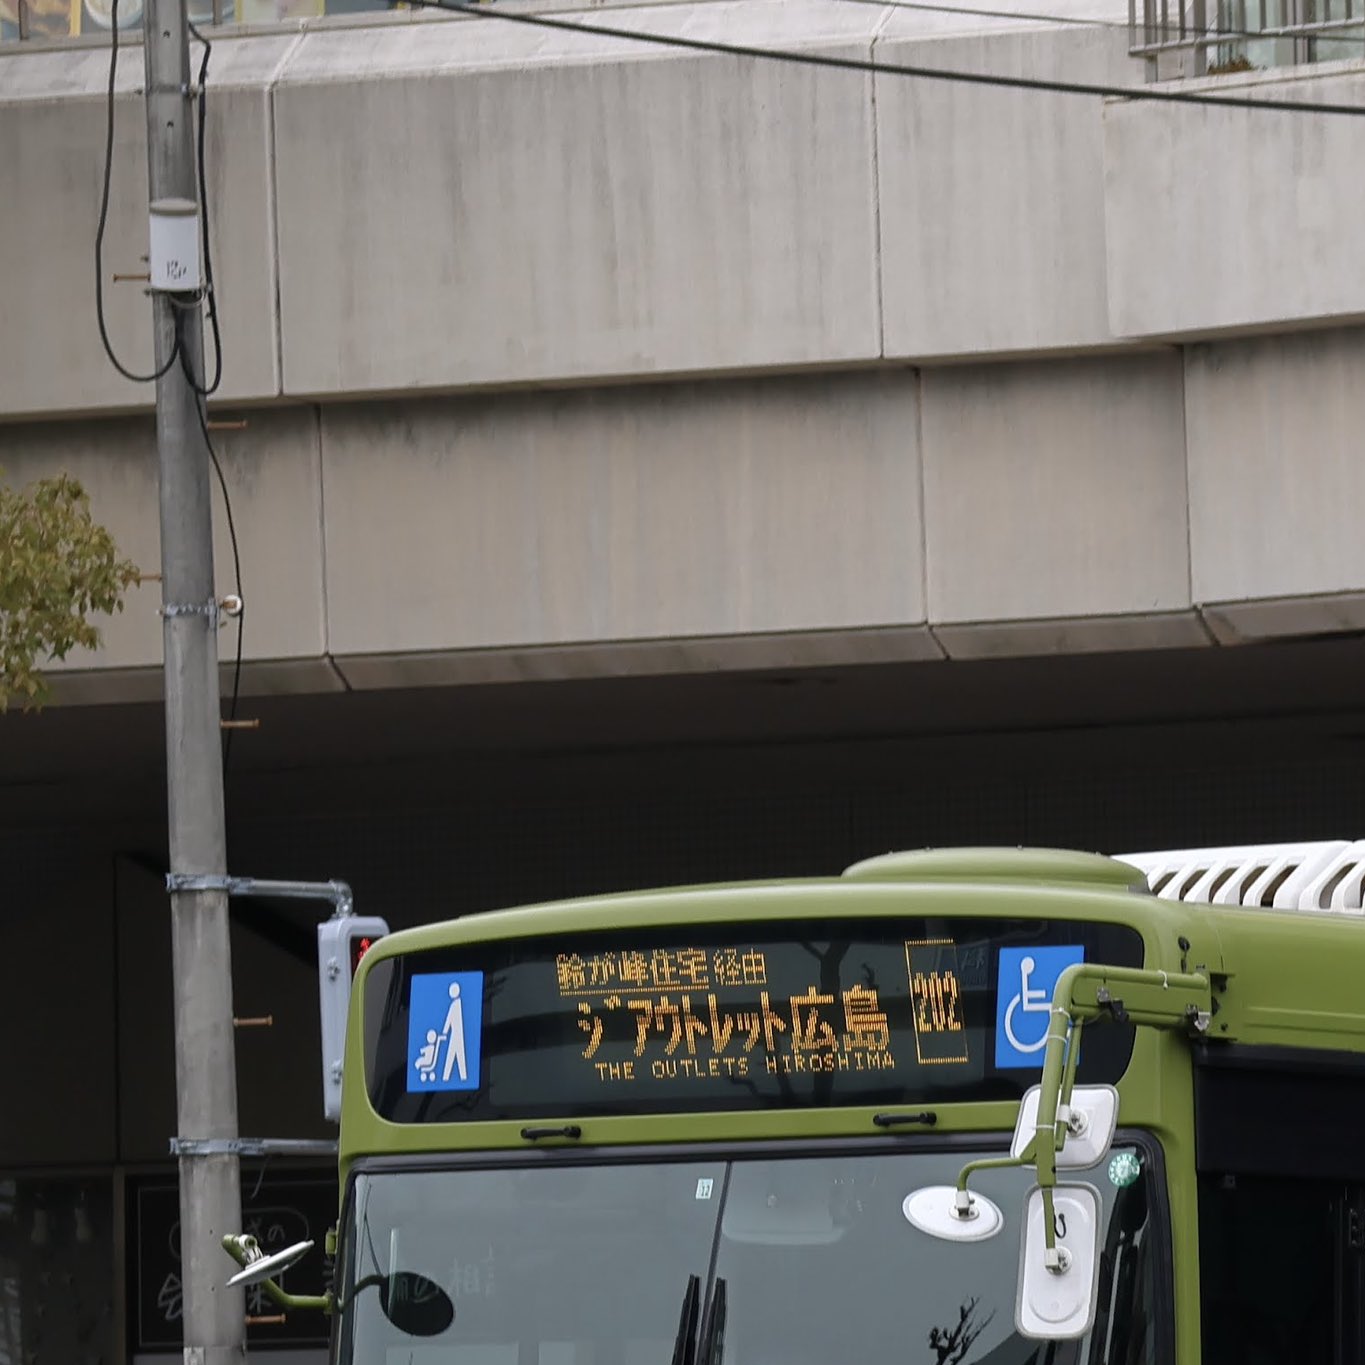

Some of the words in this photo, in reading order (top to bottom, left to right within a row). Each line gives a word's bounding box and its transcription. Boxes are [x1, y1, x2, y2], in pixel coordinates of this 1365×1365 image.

[914, 971, 962, 1032] 202
[594, 1060, 635, 1080] THE
[652, 1056, 749, 1079] OUTLETS
[765, 1051, 895, 1074] HIROSHIMA
